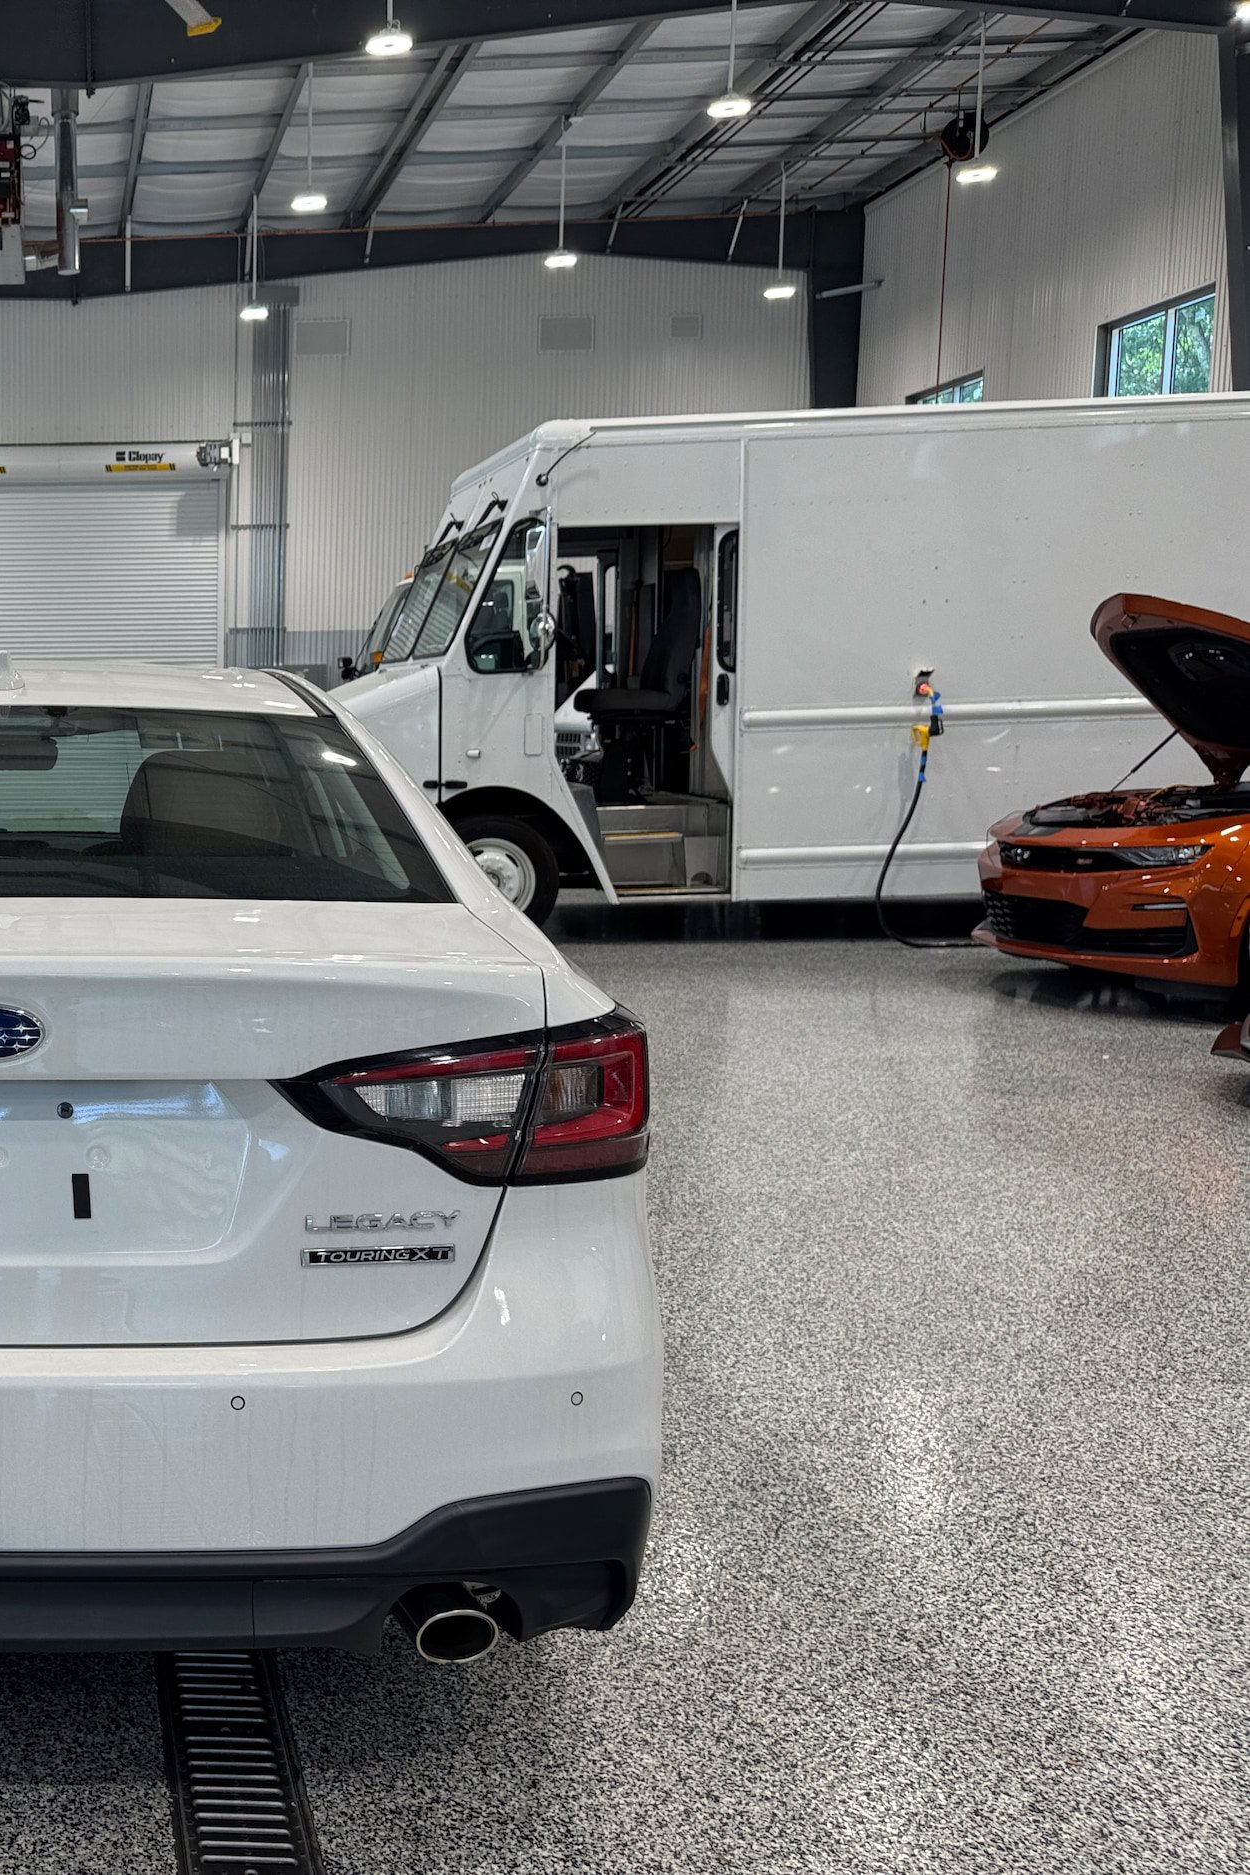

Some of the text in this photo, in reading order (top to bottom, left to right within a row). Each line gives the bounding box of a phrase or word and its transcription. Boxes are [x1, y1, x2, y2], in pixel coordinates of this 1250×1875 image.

[128, 450, 164, 463] Clopay
[305, 1210, 461, 1231] LEGACY
[317, 1249, 411, 1263] TOURING
